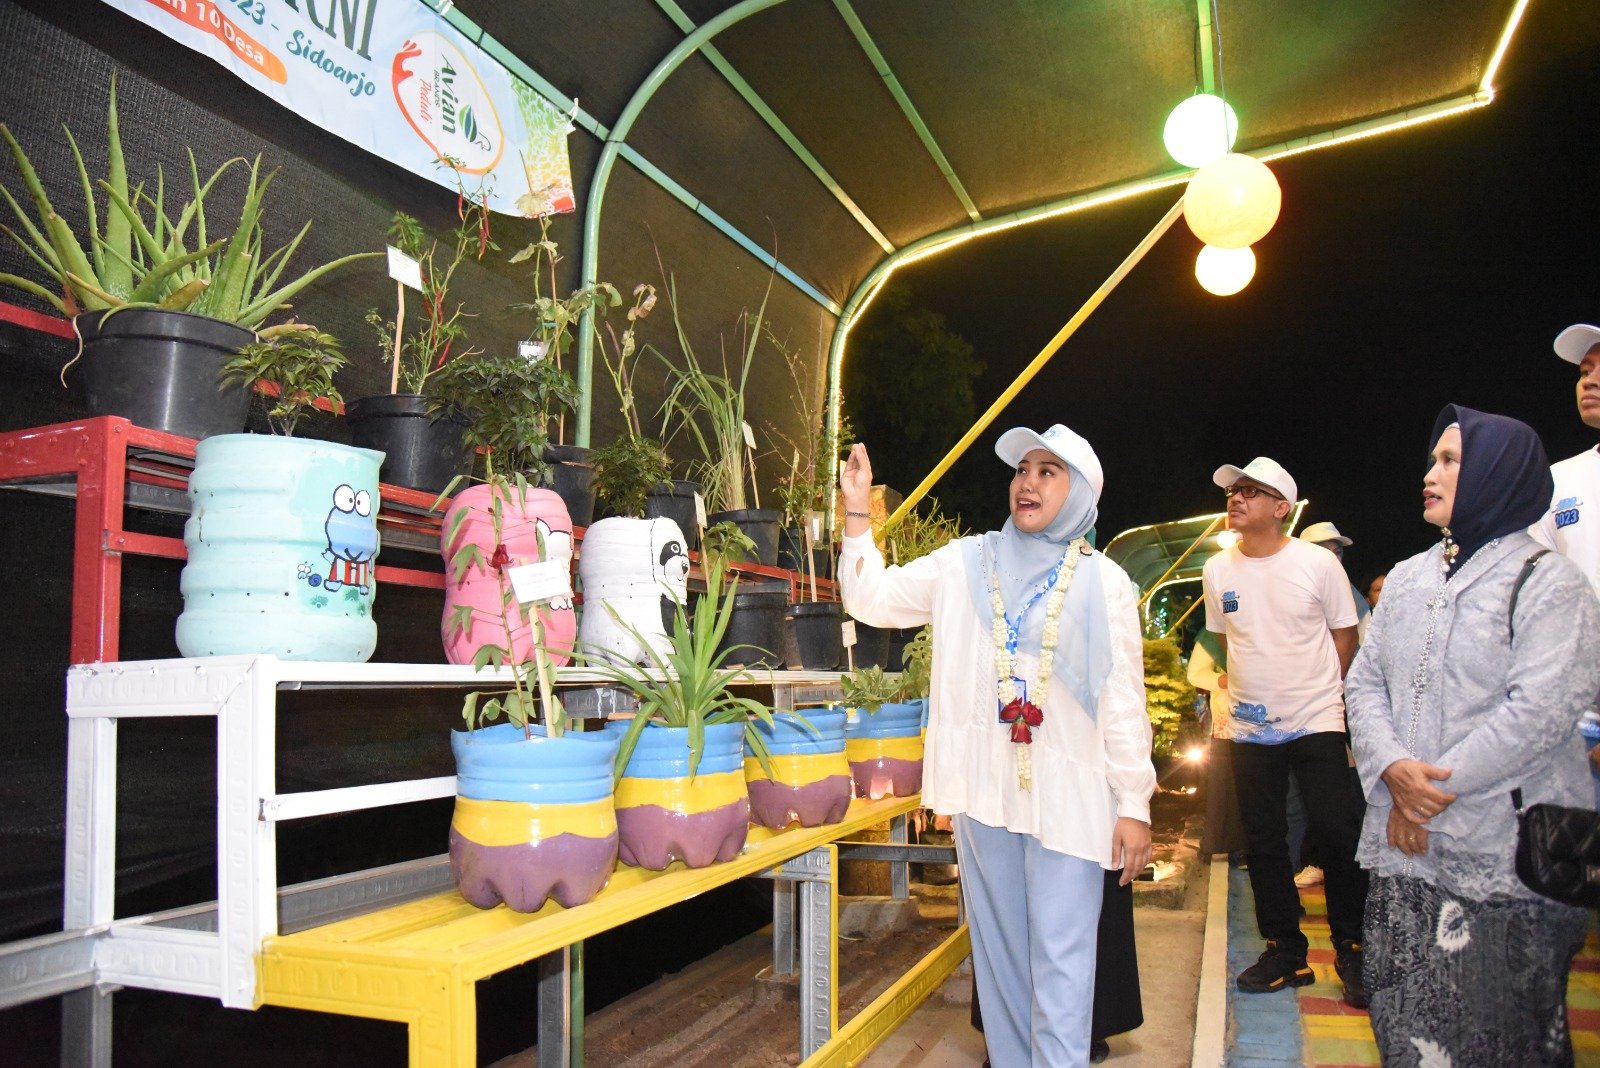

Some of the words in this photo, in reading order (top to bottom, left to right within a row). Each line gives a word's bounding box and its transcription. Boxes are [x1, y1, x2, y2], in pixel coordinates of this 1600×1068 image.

[223, 19, 265, 67] Desa
[228, 0, 266, 25] 23
[286, 29, 376, 97] Sidoarjo
[419, 78, 433, 124] Peduli
[433, 69, 441, 109] BRANDS
[441, 52, 459, 135] Avian
